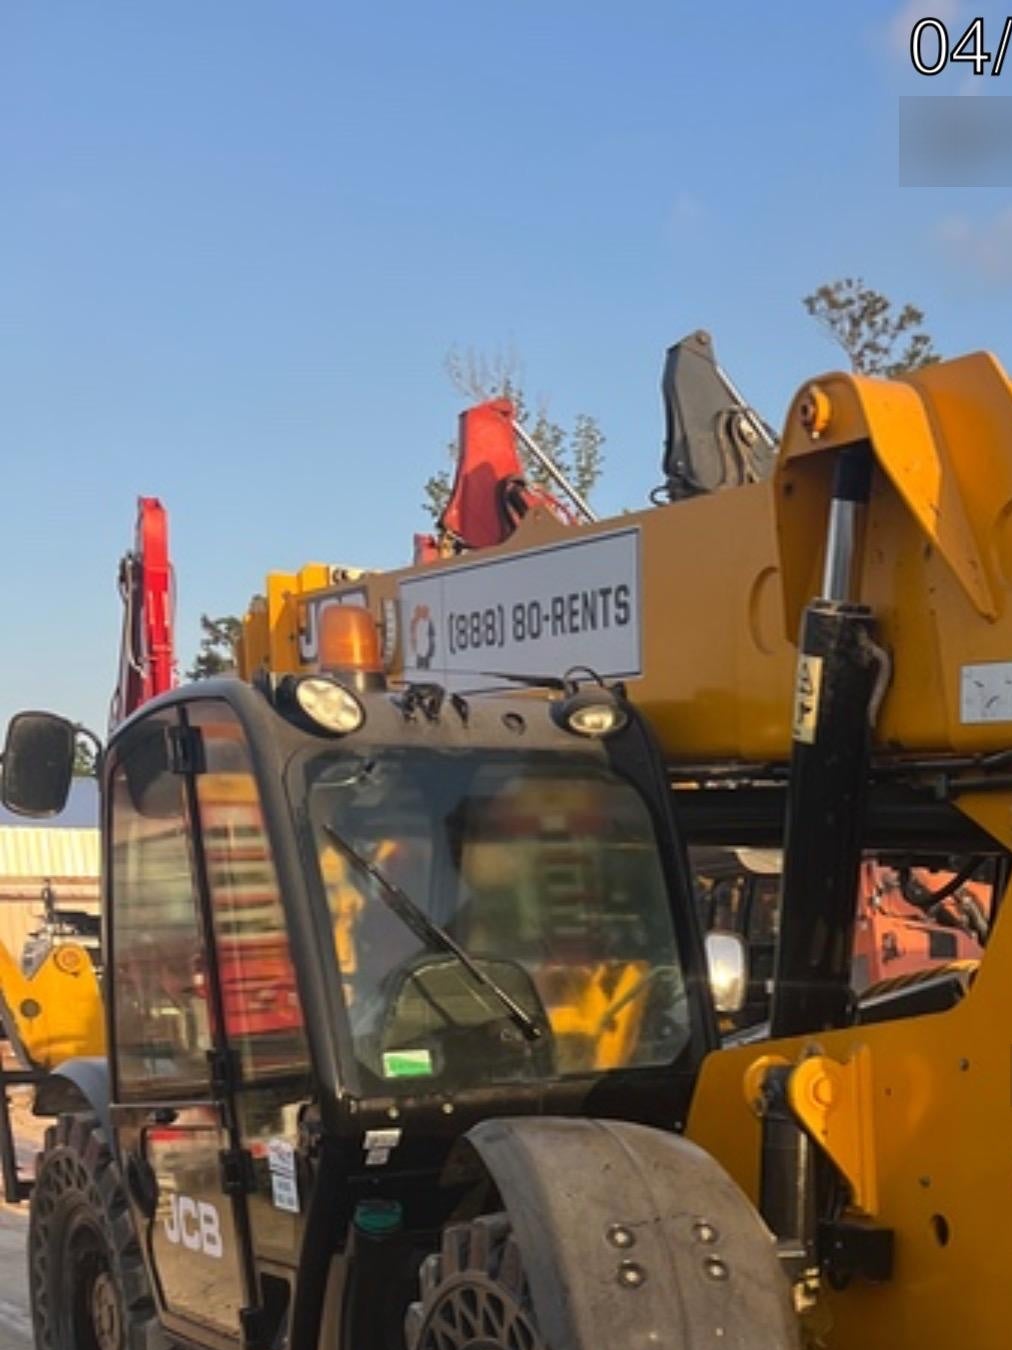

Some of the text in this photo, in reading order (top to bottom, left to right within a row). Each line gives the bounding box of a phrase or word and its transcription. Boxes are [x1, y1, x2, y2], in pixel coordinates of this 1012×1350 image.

[448, 584, 630, 655] (888) 80-RENTS
[163, 1193, 222, 1258] JCB
